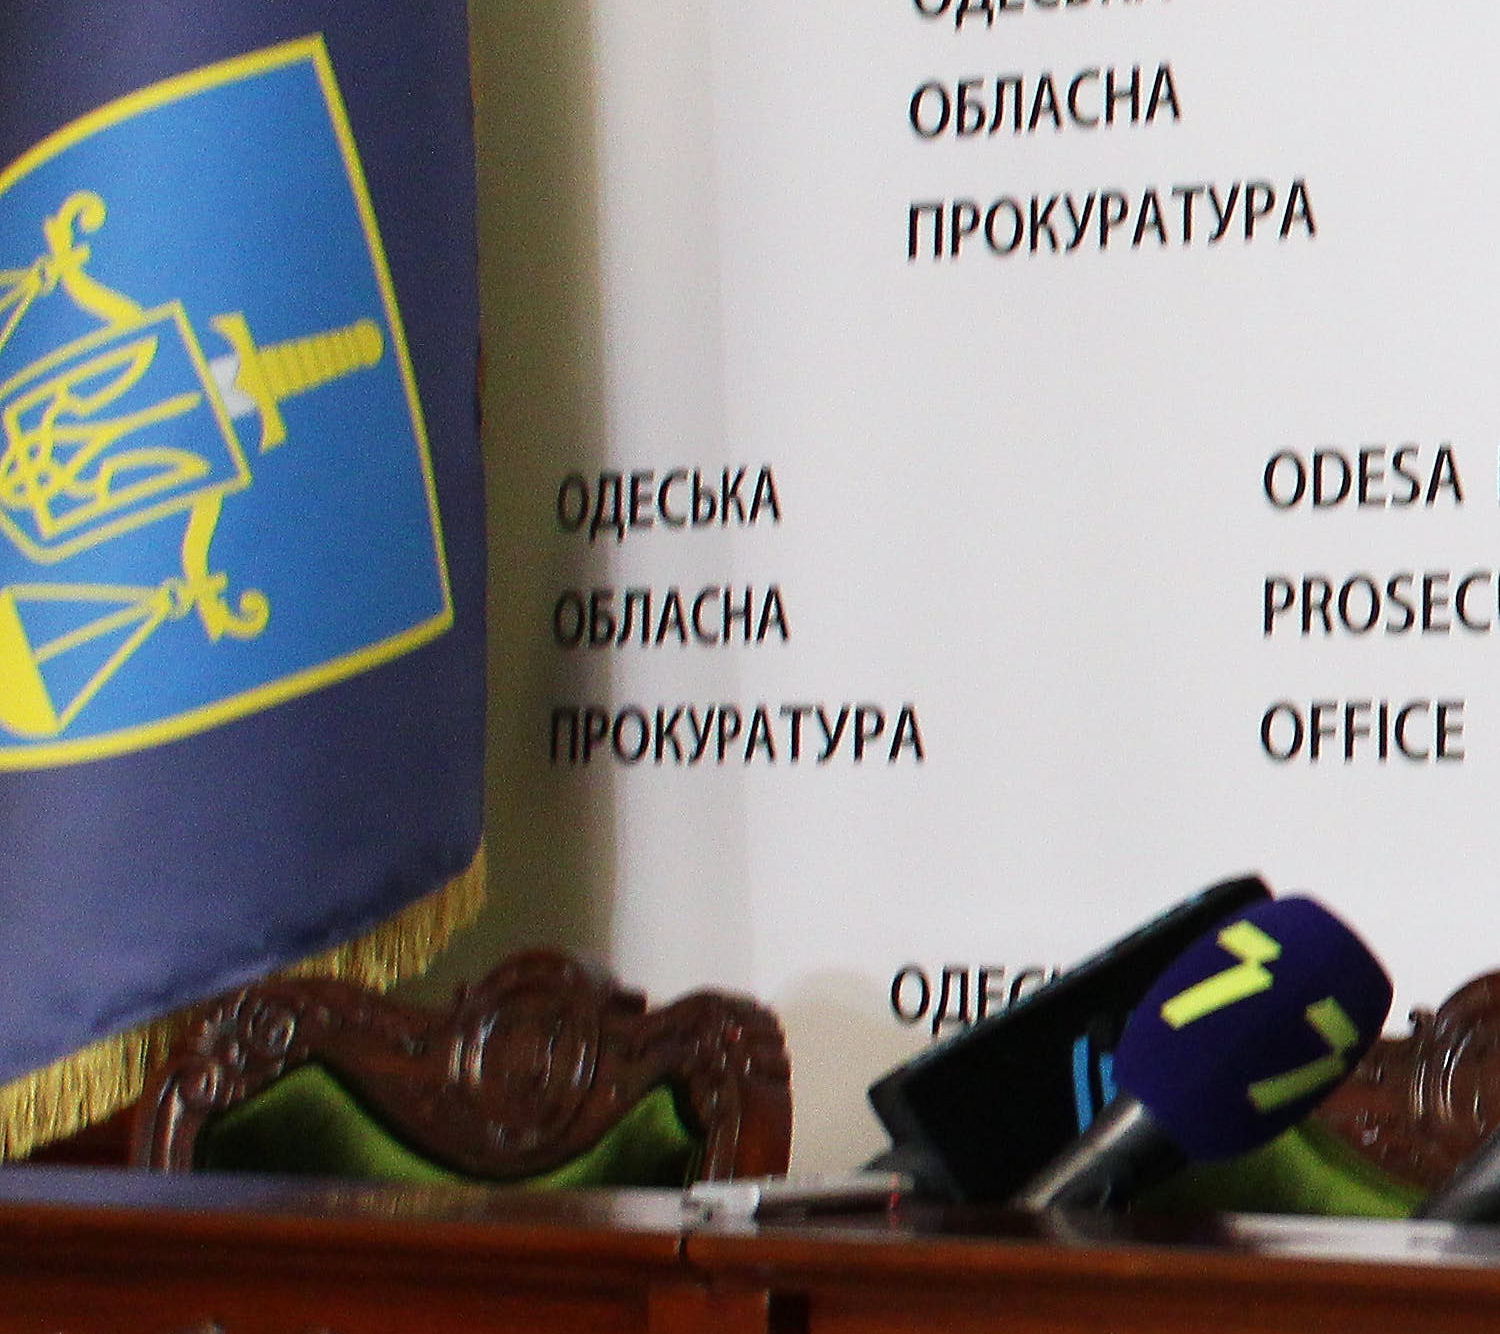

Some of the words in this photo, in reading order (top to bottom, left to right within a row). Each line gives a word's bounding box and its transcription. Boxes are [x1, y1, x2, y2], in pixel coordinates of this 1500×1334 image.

[907, 63, 1182, 140] ОБЛАСНА
[906, 178, 1318, 261] ПРОКУРАТУРА
[556, 464, 782, 544] ОДЕСЬКА
[1262, 444, 1465, 511] ODESA
[553, 584, 791, 649] ОБЛАСНА
[550, 704, 926, 766] ПРОКУРАТУРА
[1259, 700, 1465, 763] OFFICE
